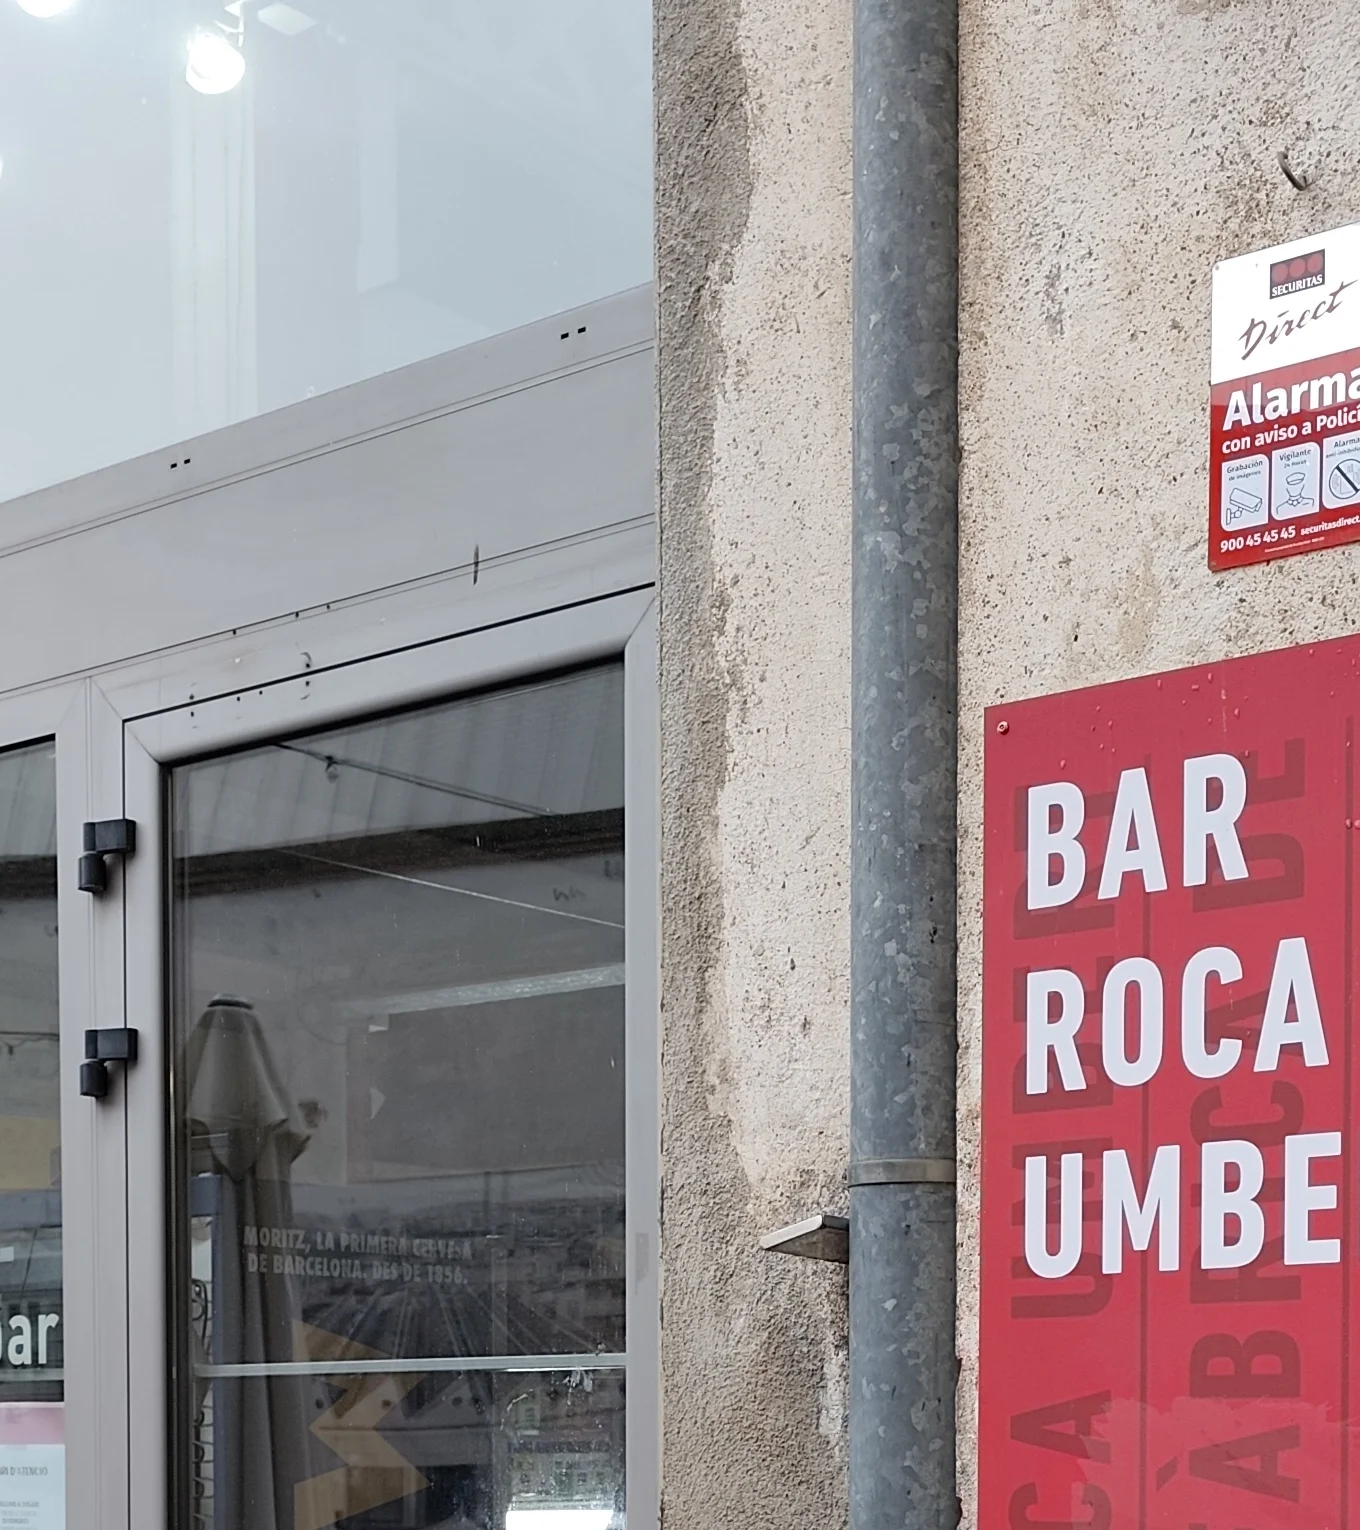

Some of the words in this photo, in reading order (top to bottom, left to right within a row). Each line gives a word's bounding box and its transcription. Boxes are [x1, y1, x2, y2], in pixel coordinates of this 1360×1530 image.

[1271, 274, 1323, 297] SECURITAS
[1238, 279, 1359, 360] Direct
[1222, 435, 1251, 454] con
[1254, 421, 1297, 447] aviso
[1301, 421, 1312, 435] a
[1333, 436, 1360, 449] Alarma
[1226, 459, 1263, 474] Grabación
[1279, 448, 1312, 462] Vigilante
[1220, 537, 1244, 554] 900
[1246, 531, 1262, 548] 45
[1263, 528, 1279, 543] 45
[1280, 525, 1296, 541] 45
[1026, 752, 1251, 911] BAR
[1025, 936, 1330, 1095] ROCA
[243, 1226, 312, 1254] MORITZ,
[316, 1231, 335, 1251] LA
[340, 1233, 409, 1256] PRIMERA
[412, 1238, 473, 1261] CERVESA
[248, 1253, 268, 1273] DE
[272, 1254, 368, 1279] BARCELONA.
[372, 1260, 398, 1281] DES
[402, 1262, 421, 1282] DE
[427, 1264, 468, 1285] 1856.
